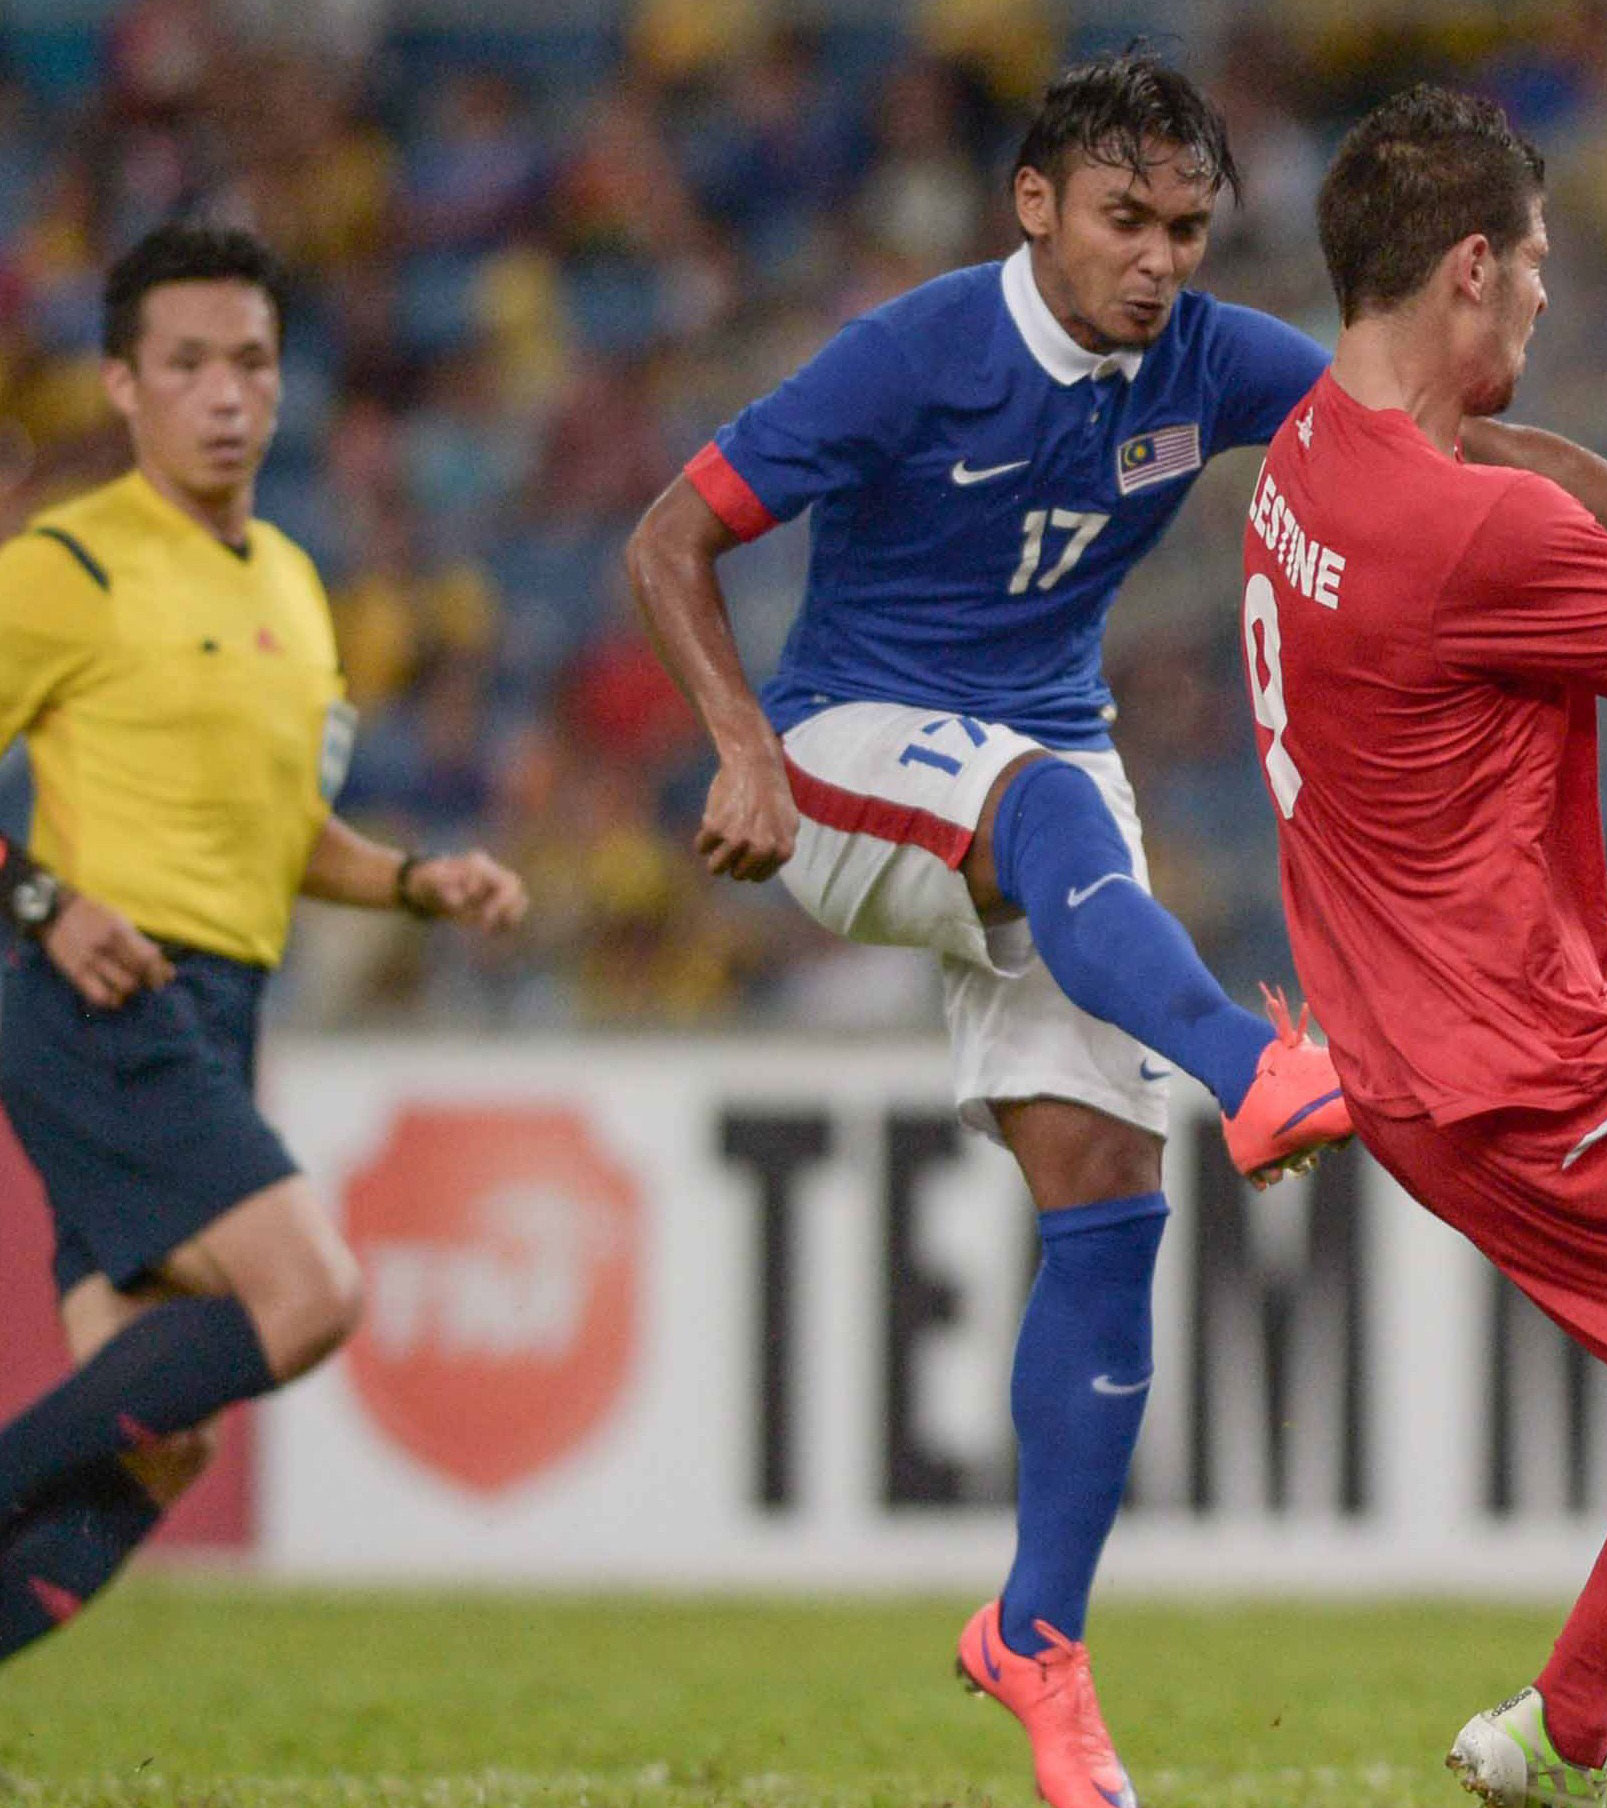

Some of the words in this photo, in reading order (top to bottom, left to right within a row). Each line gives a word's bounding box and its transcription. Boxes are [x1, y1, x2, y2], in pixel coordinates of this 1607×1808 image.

[1009, 508, 1111, 594] 17
[1250, 456, 1346, 610] LESTINE
[899, 716, 988, 776] 17
[1245, 573, 1303, 819] 9
